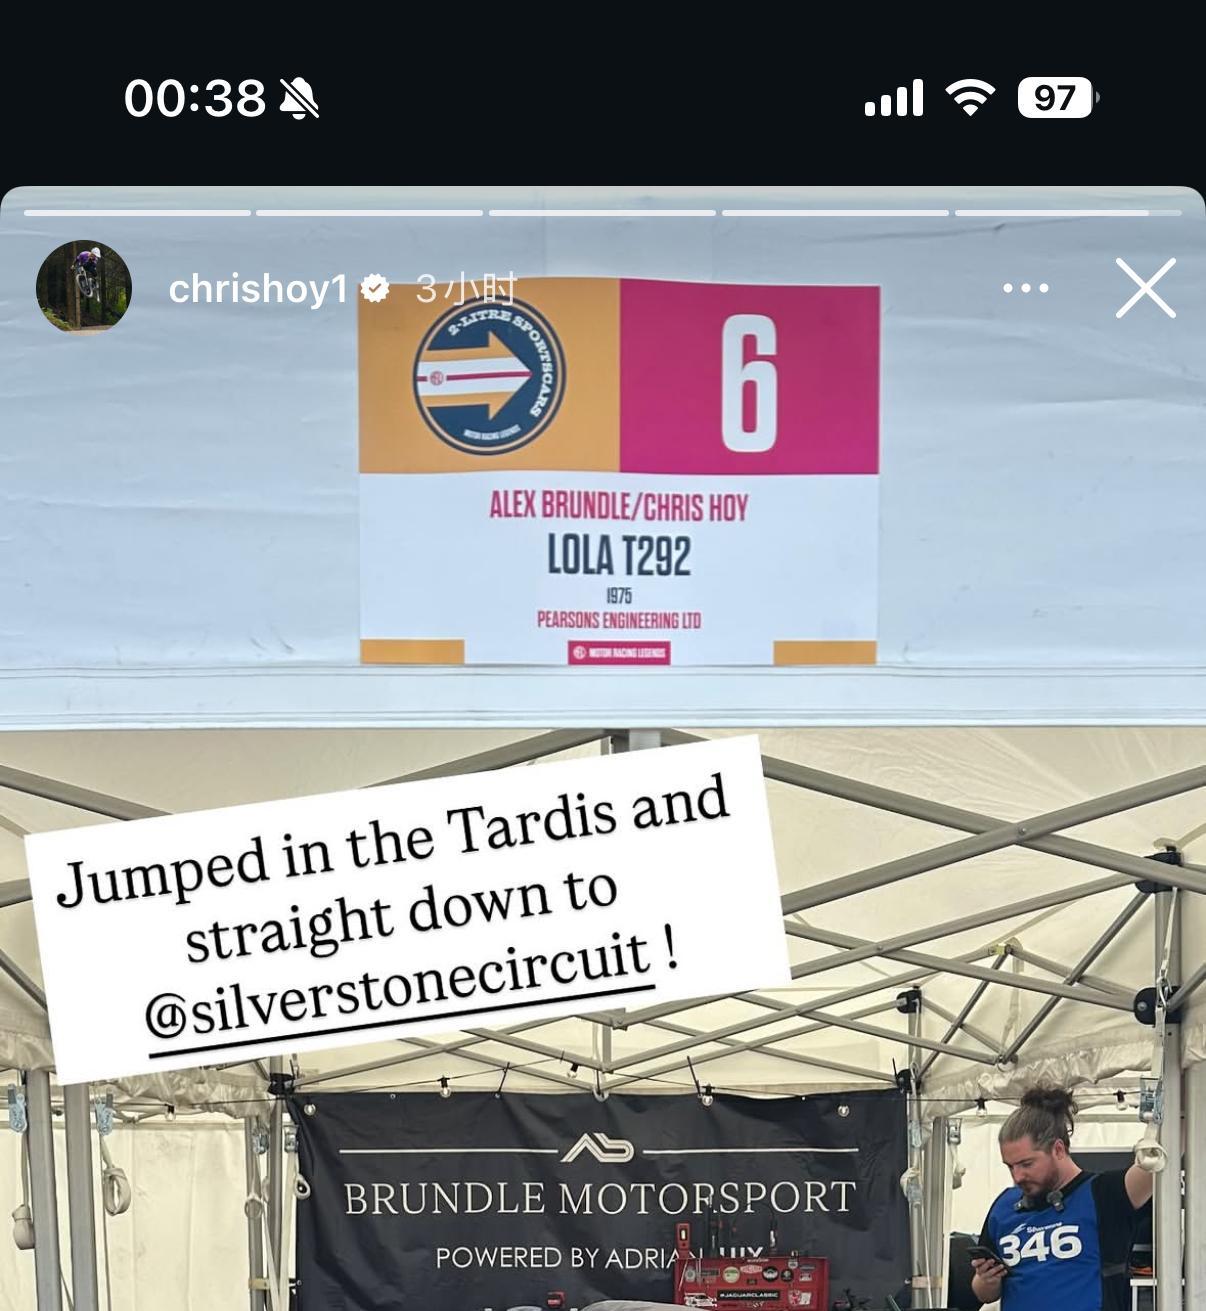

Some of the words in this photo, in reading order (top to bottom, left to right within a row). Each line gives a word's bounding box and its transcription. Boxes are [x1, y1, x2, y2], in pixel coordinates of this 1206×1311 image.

[448, 309, 512, 336] 2-LITRE
[511, 315, 553, 417] SPORTSCARS
[721, 314, 779, 453] 6
[490, 490, 536, 518] ALEX
[542, 490, 704, 521] BRUNDLE/CHRIS
[709, 493, 748, 521] HOY
[548, 532, 614, 575] LOLA
[622, 534, 692, 576] T292
[607, 586, 632, 604] 1975
[537, 610, 600, 628] PEARSONS
[603, 611, 679, 629] ENGINEERING
[682, 612, 702, 629] LTD
[344, 1182, 545, 1215] BRUNDLE
[559, 1181, 857, 1215] MOTORSPORT
[436, 1246, 562, 1268] POWERED
[571, 1247, 599, 1268] BY
[999, 1225, 1082, 1267] 346
